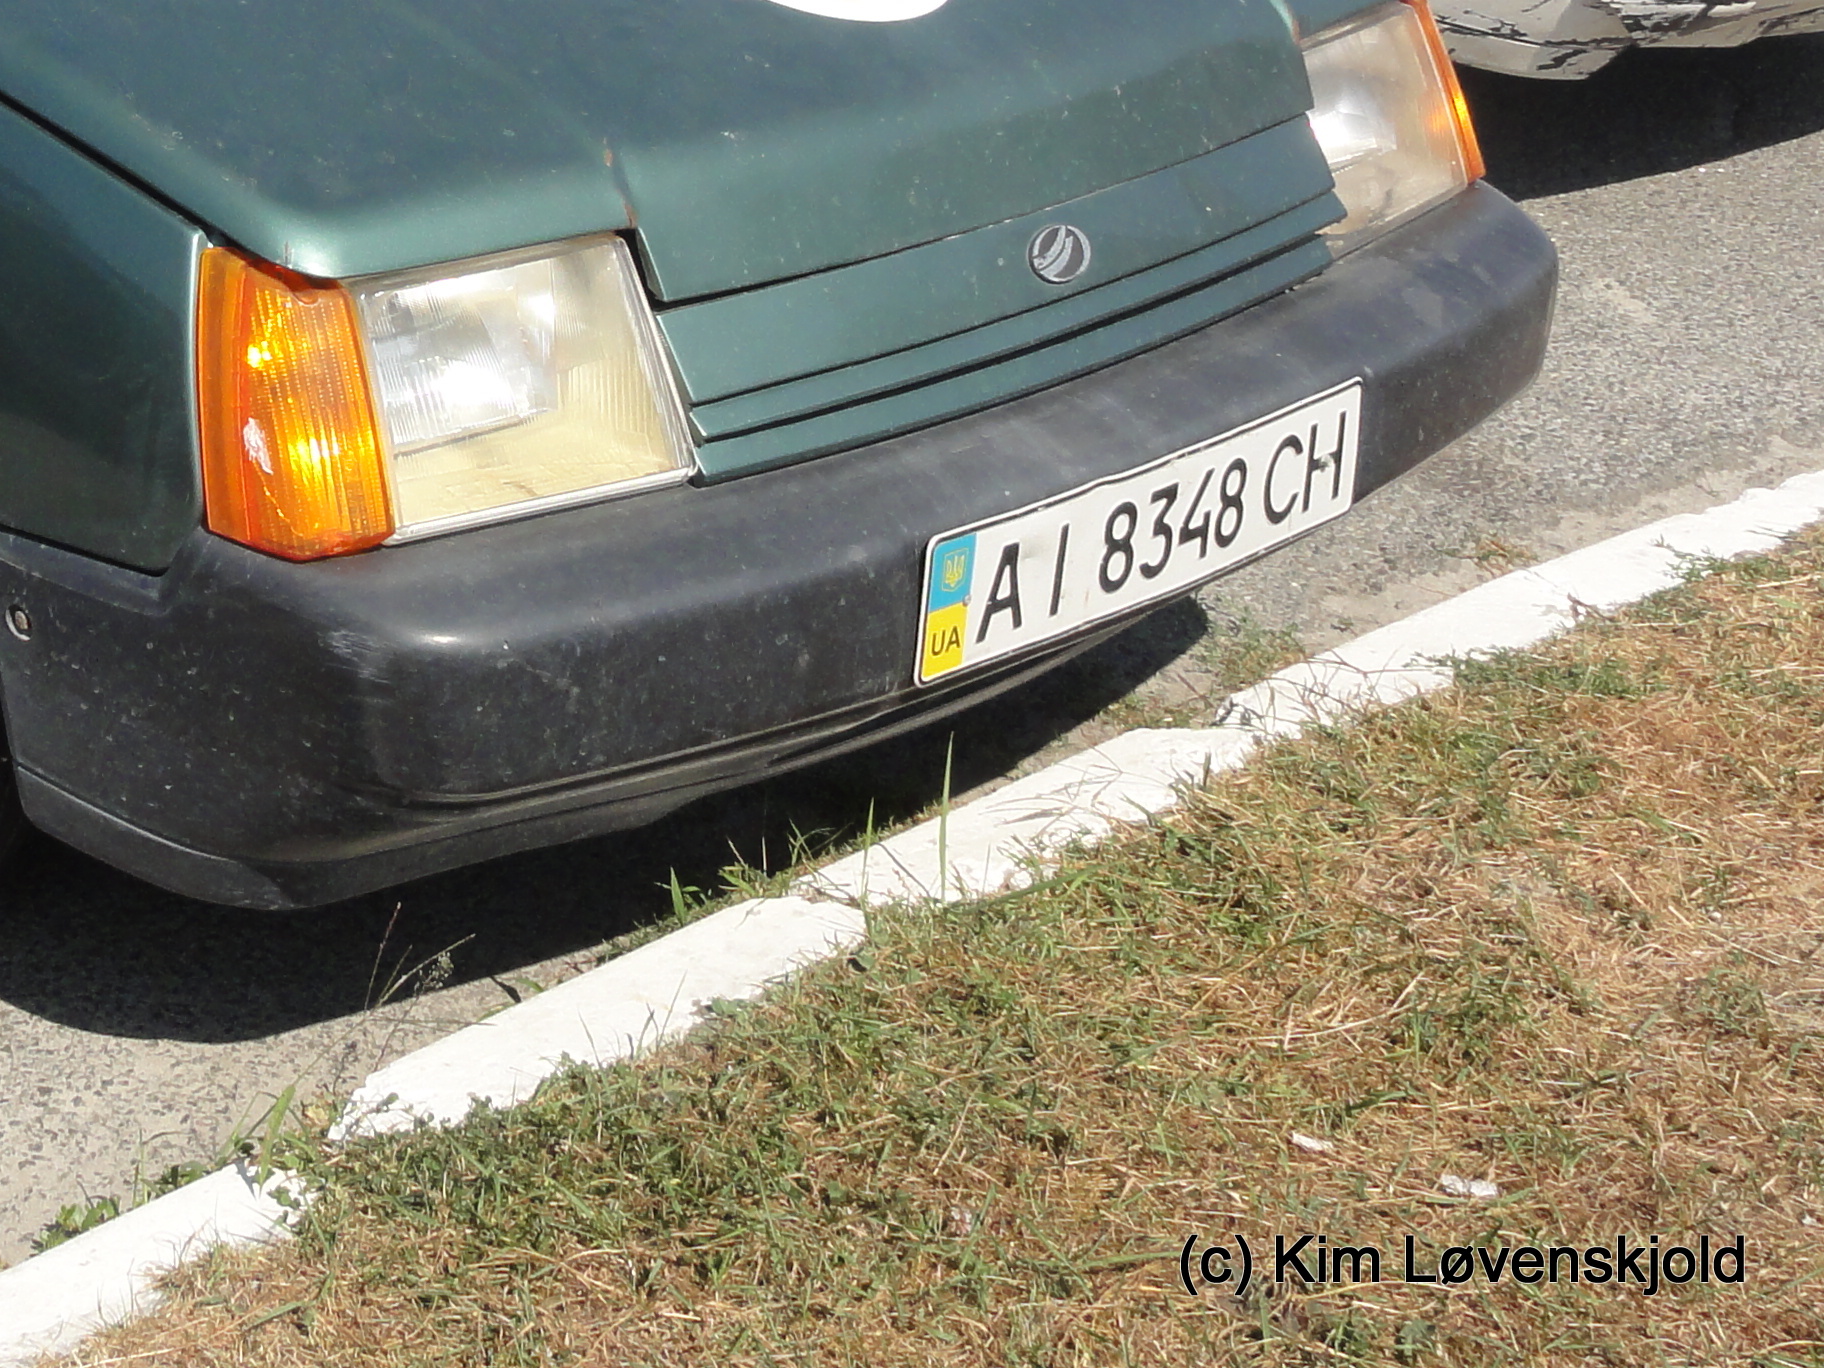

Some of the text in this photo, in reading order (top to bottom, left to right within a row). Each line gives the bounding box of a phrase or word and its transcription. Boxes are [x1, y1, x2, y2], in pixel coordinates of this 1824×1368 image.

[976, 410, 1347, 644] AI 8348 CH
[930, 624, 962, 657] UA
